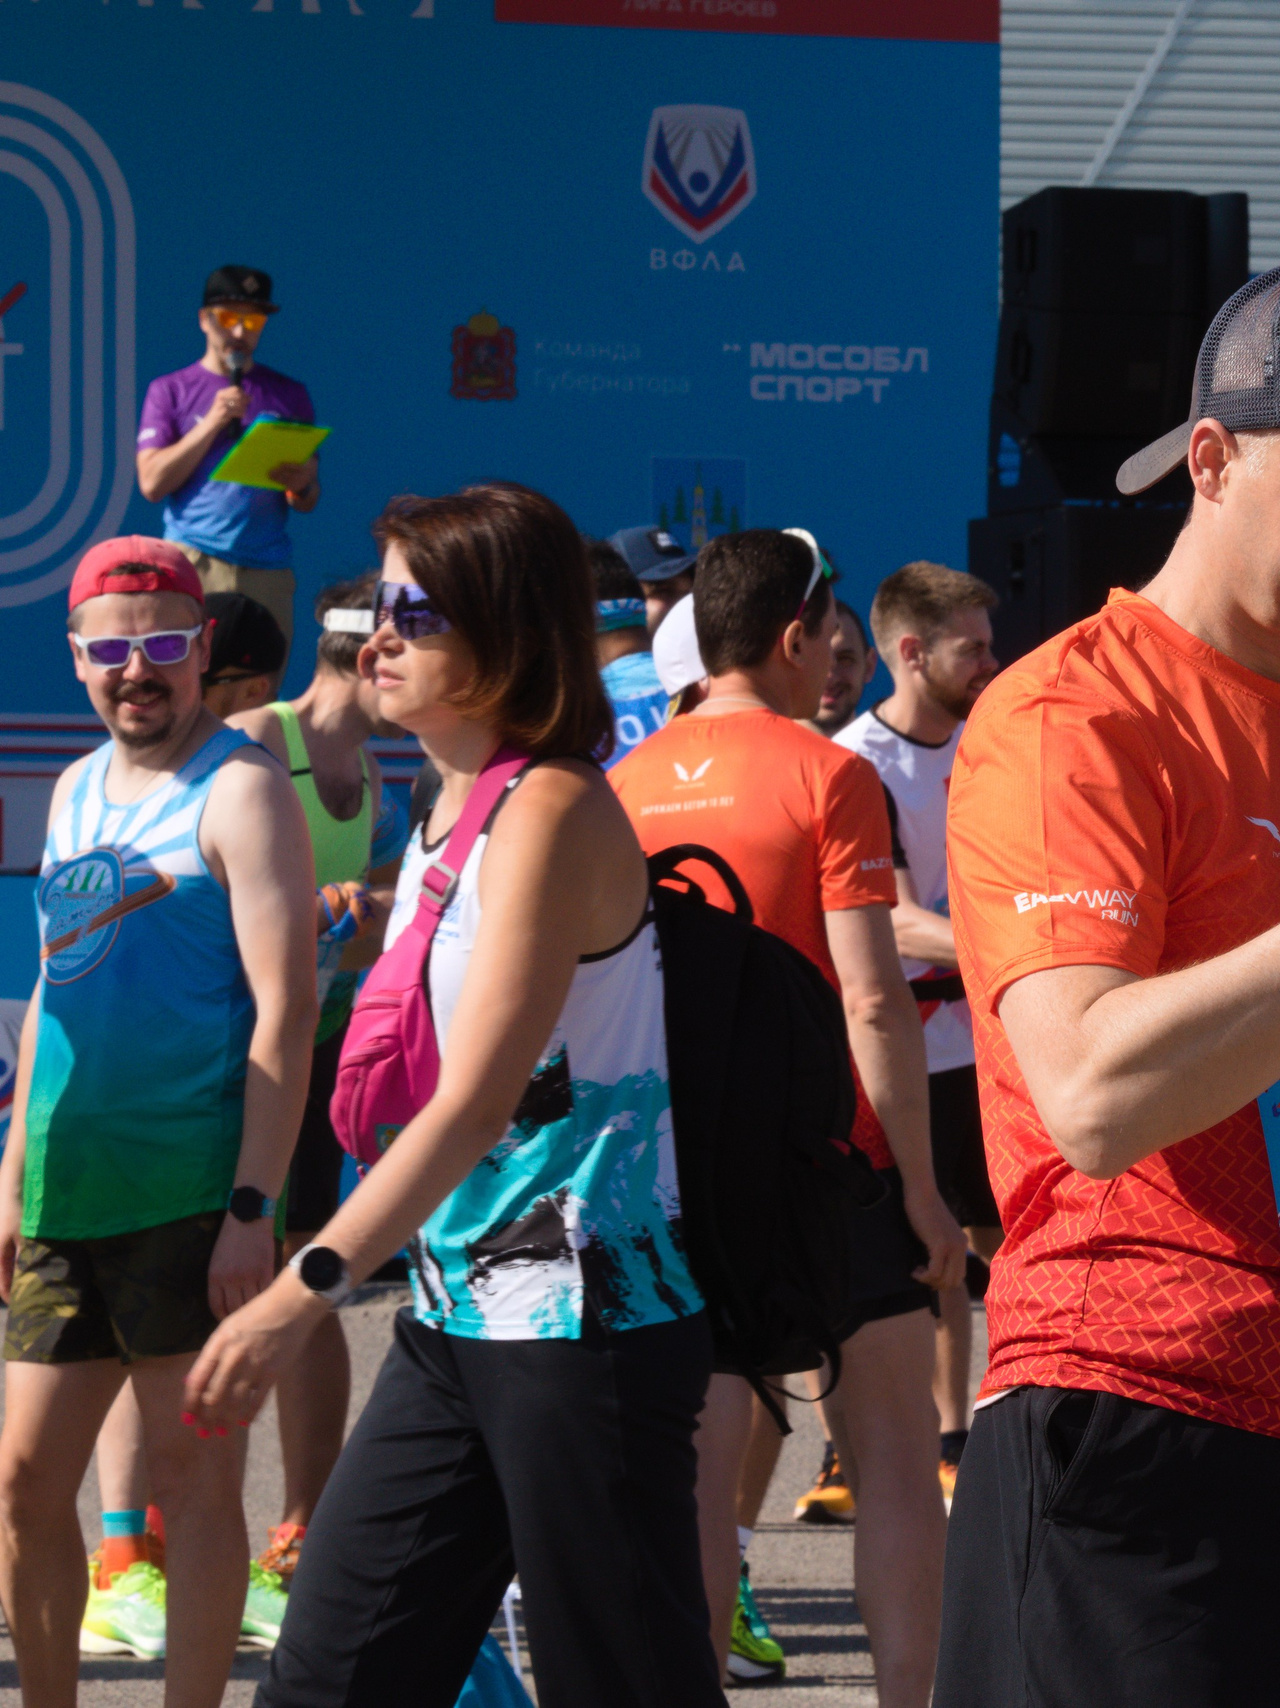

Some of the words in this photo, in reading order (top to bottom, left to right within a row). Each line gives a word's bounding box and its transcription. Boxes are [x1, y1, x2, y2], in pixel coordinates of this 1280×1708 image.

[649, 248, 747, 273] ВФЛА
[749, 342, 930, 374] МОСОБЛ
[749, 374, 890, 404] СПОРТ
[1101, 909, 1139, 927] RUN
